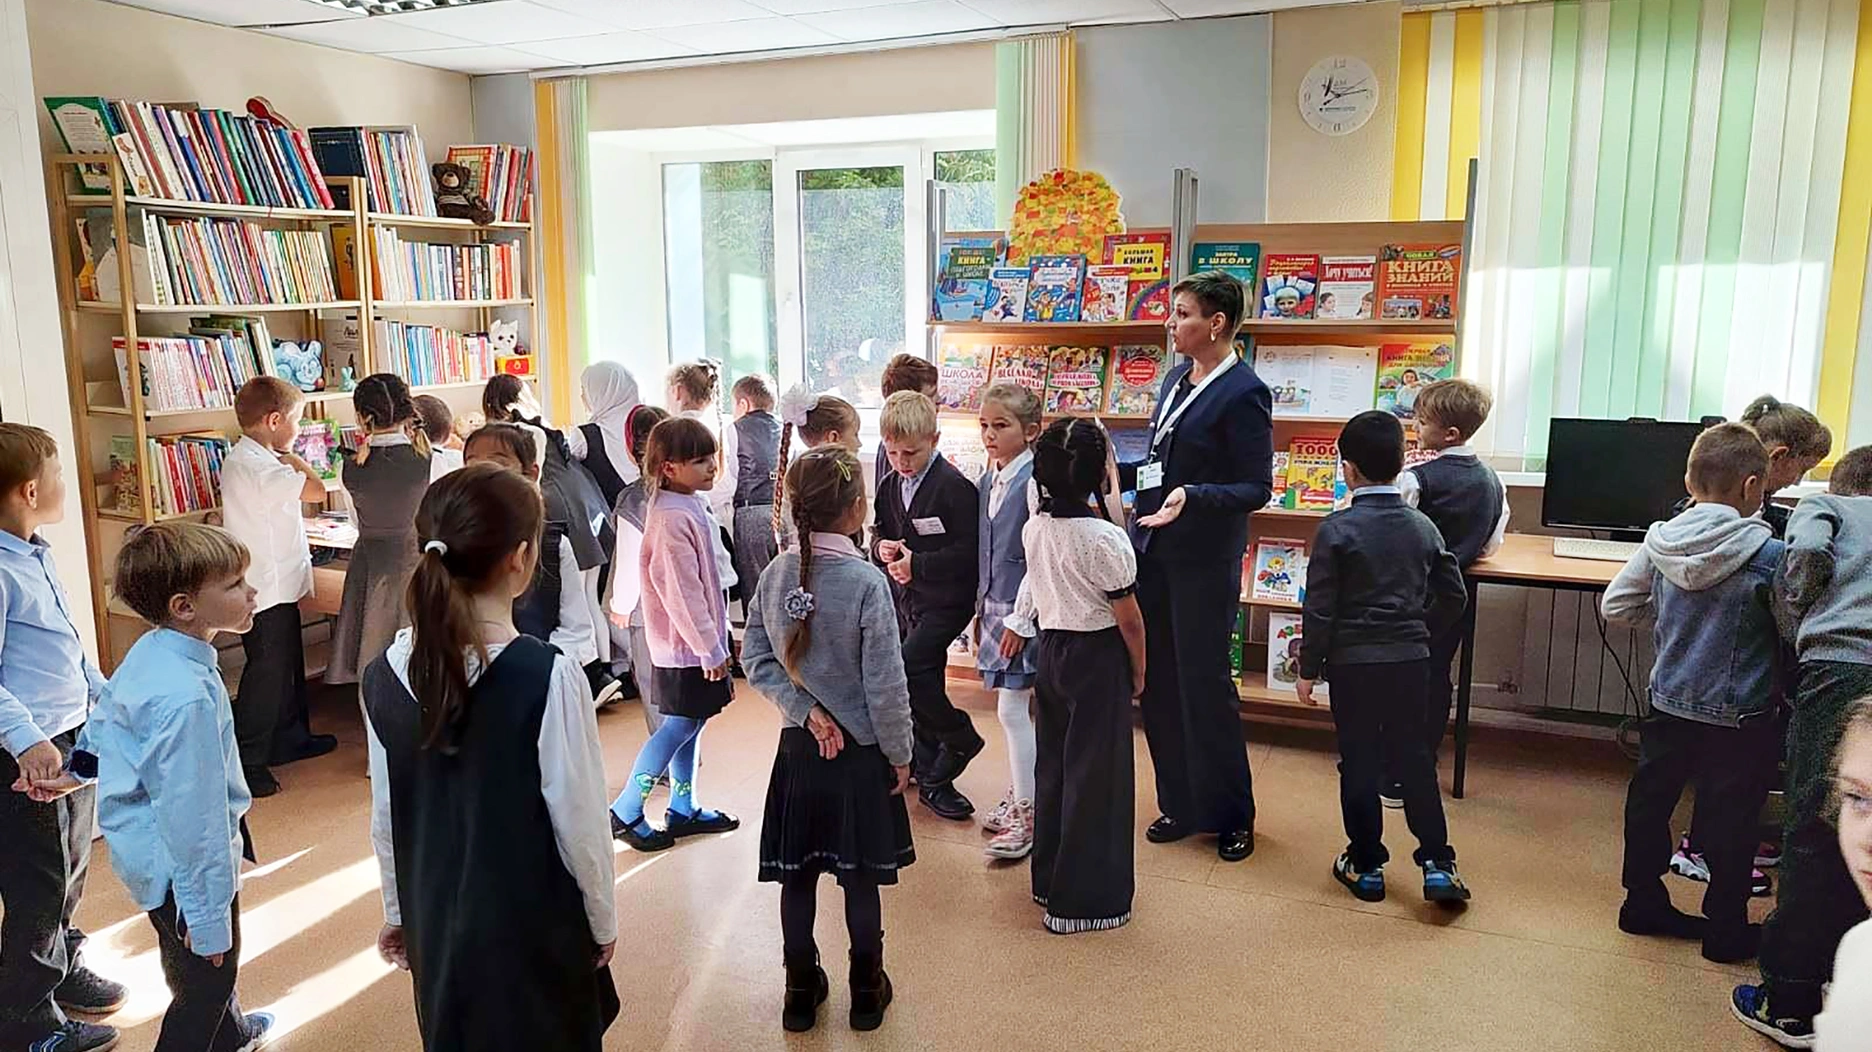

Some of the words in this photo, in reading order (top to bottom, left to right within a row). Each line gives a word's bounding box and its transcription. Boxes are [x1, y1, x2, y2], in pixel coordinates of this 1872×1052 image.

[957, 256, 985, 264] КНИГА
[1123, 256, 1154, 264] КНИГА
[1208, 257, 1254, 265] ШКОЛУ
[1387, 260, 1454, 273] КНИГА
[1386, 272, 1454, 283] ЗНАНИЙ
[941, 368, 983, 379] ШКОЛА
[1296, 444, 1338, 456] 1000
